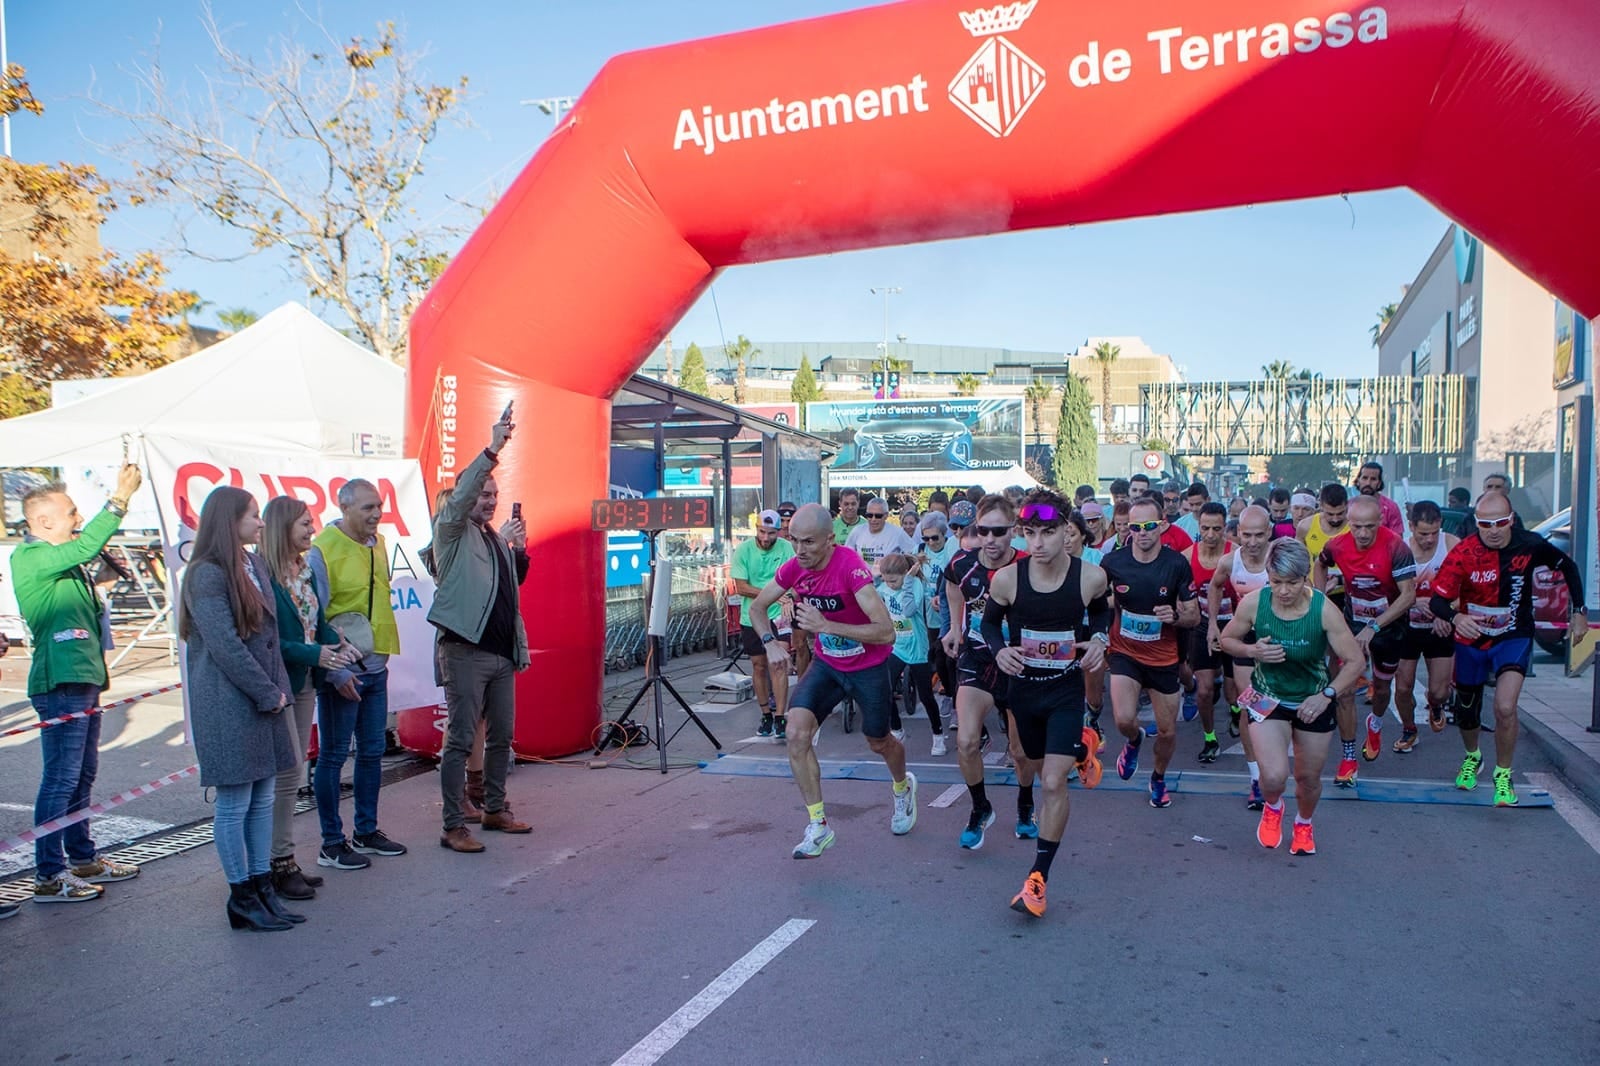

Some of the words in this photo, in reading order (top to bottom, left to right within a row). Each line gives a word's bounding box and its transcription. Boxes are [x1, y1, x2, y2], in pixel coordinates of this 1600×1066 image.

[673, 73, 929, 156] Ajuntament
[1068, 40, 1132, 88] de
[1147, 5, 1388, 74] Terrassa
[829, 408, 866, 417] Hyundai
[888, 405, 928, 414] d'estrena
[437, 375, 457, 483] Terrassa
[982, 460, 1018, 468] HYUNDAI
[596, 499, 708, 528] 09:31:13
[825, 598, 837, 609] 19
[1131, 619, 1151, 632] 107
[1039, 642, 1057, 656] 60
